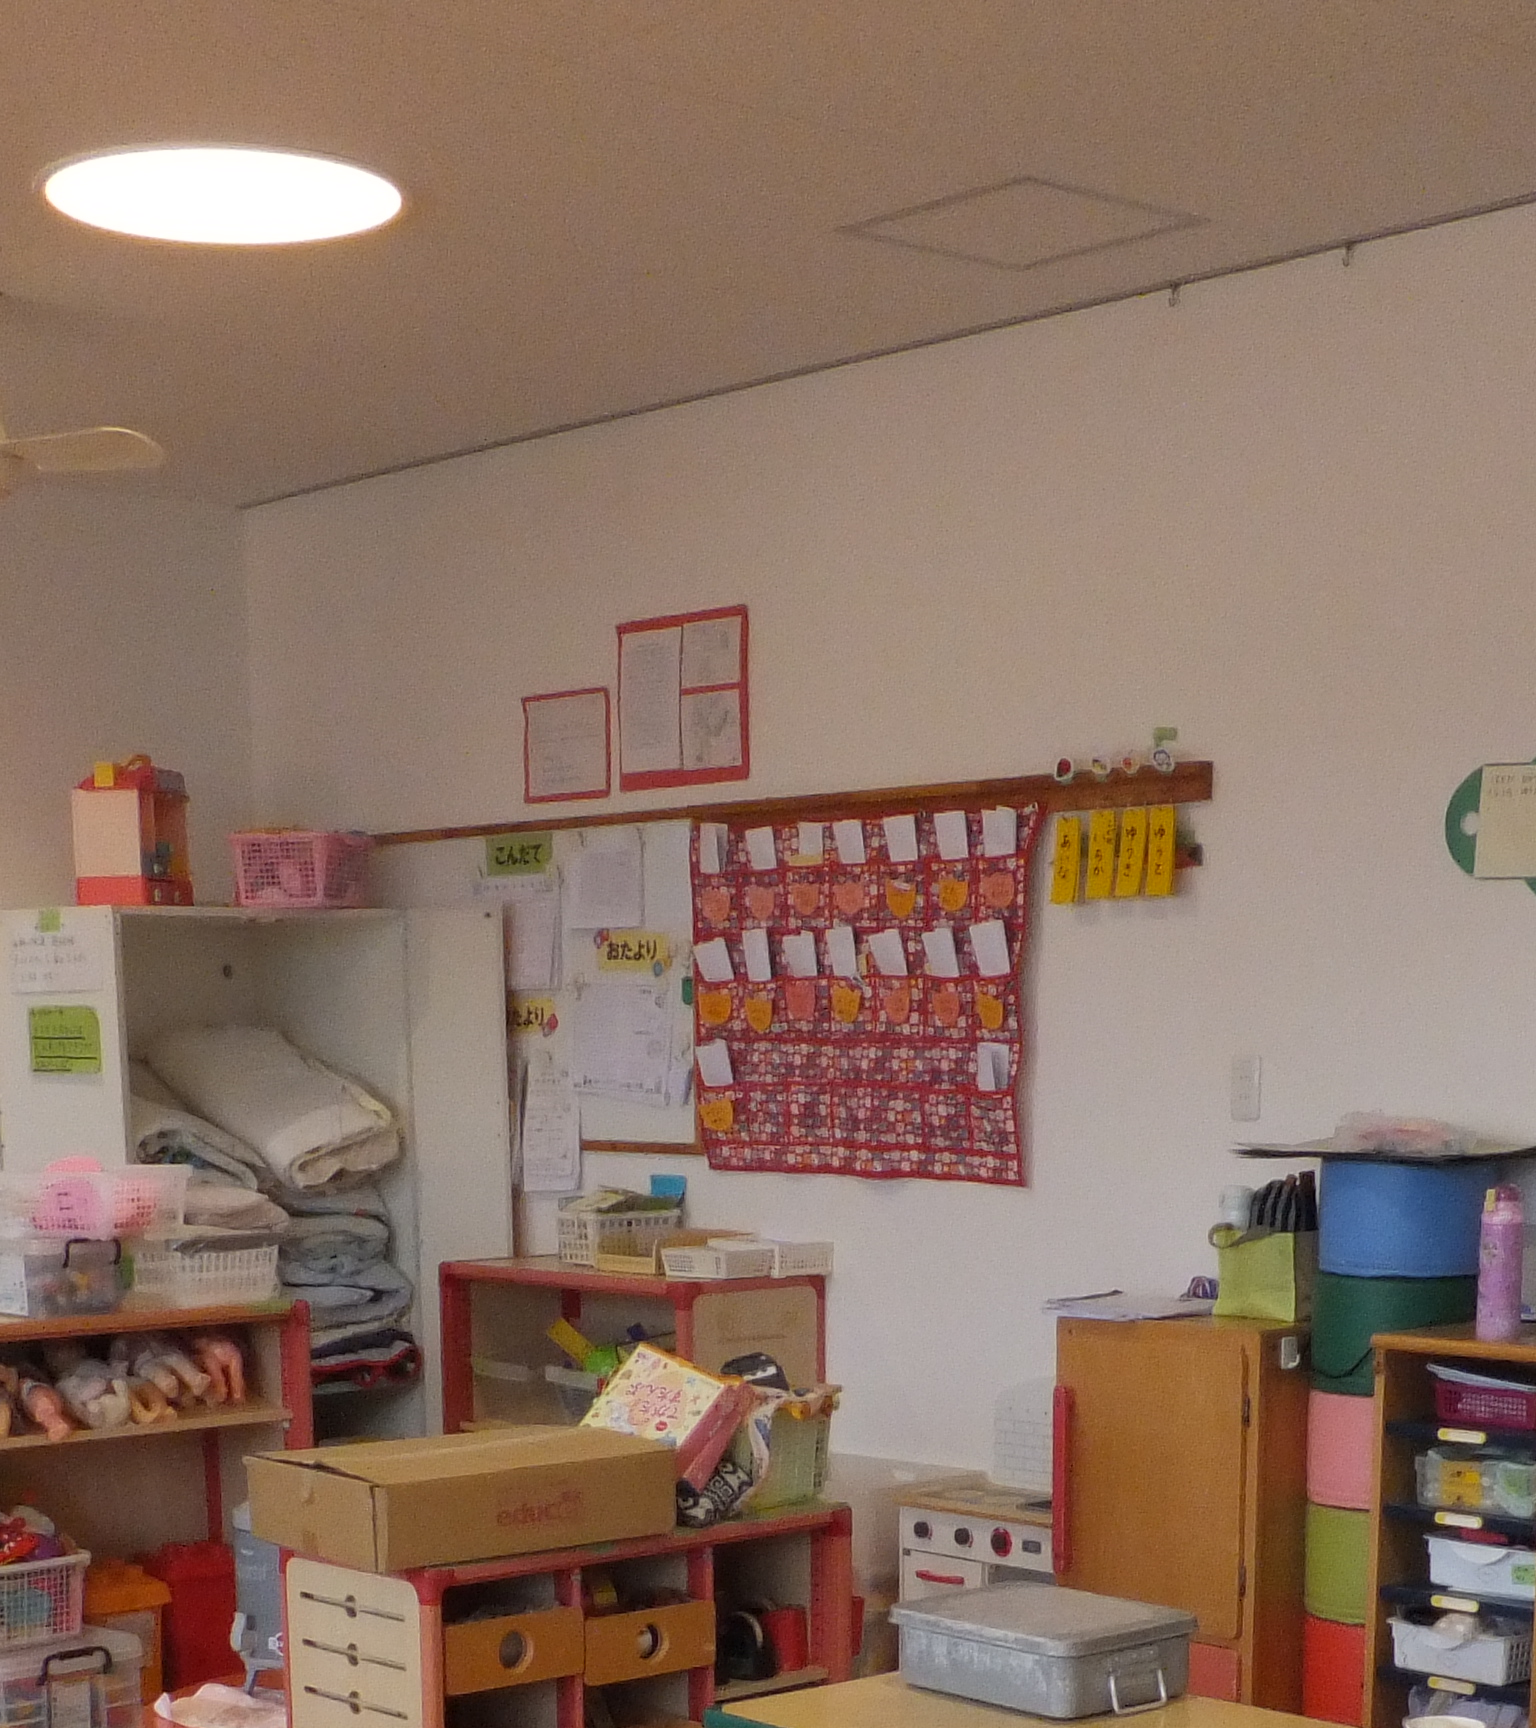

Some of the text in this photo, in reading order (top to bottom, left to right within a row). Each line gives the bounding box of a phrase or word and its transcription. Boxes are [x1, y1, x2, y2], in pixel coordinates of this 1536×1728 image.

[495, 843, 543, 866] こんだて
[606, 940, 658, 961] おたより
